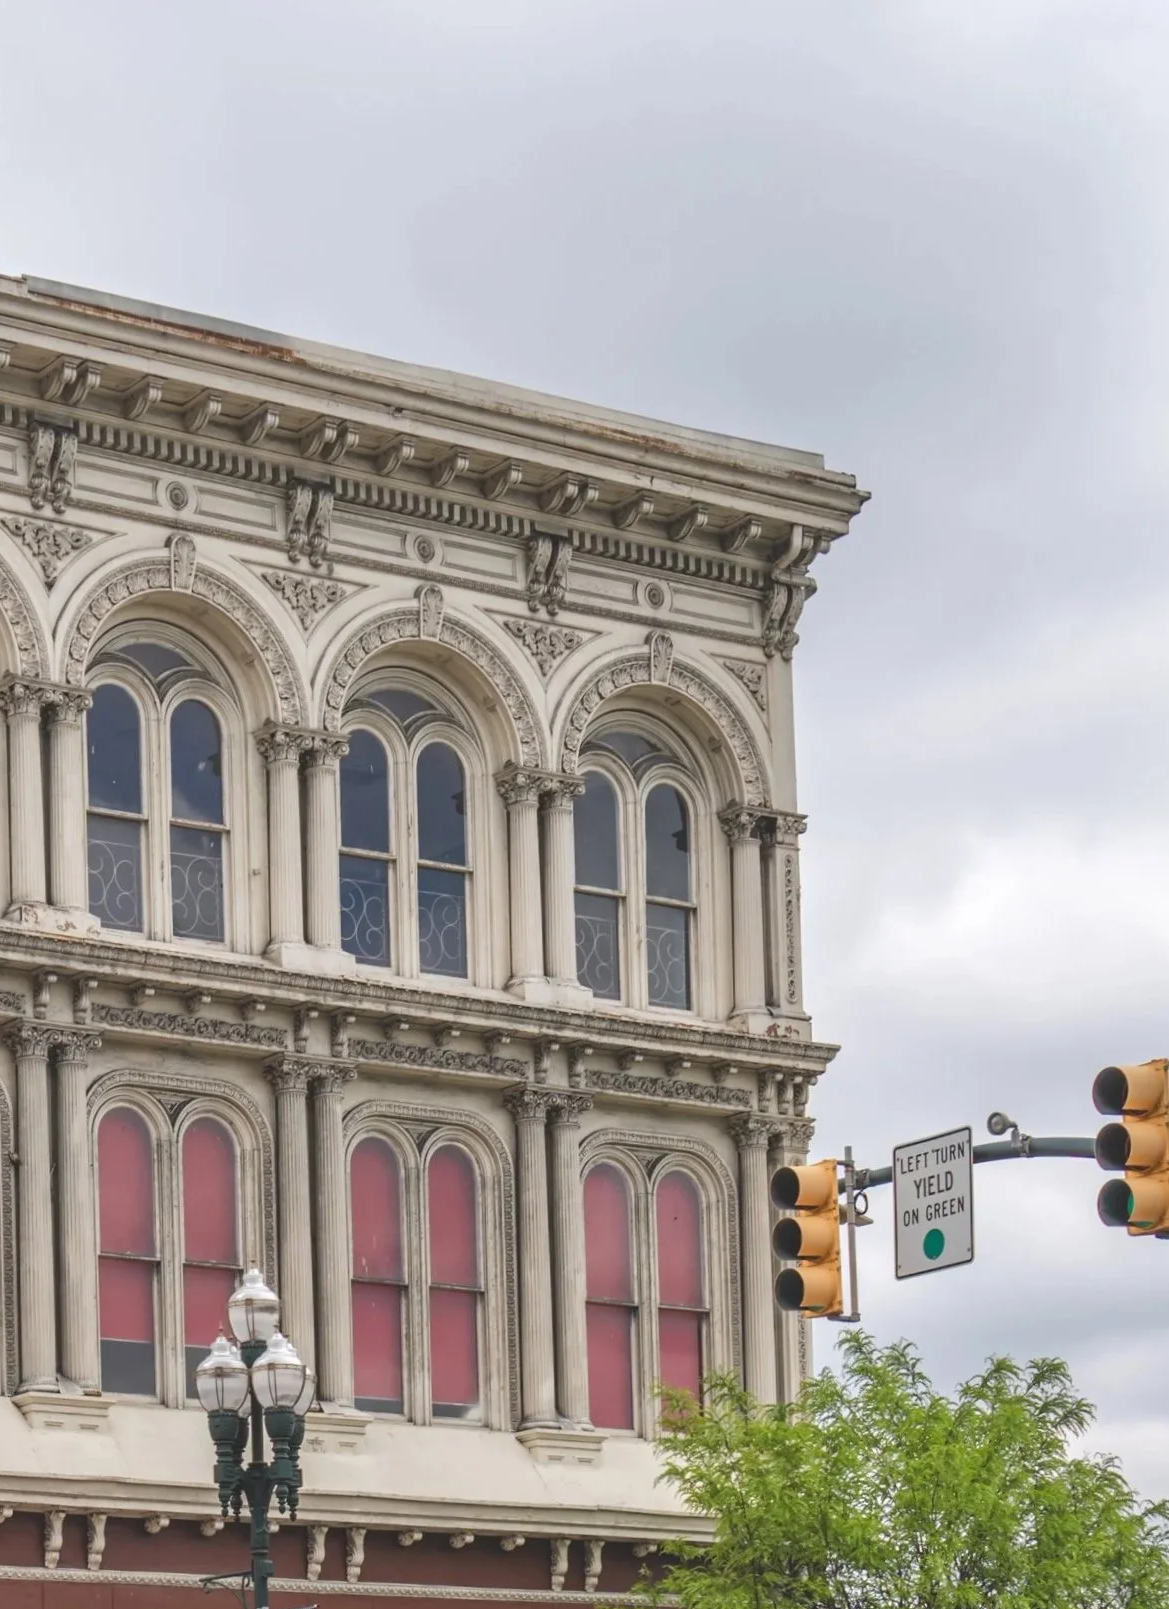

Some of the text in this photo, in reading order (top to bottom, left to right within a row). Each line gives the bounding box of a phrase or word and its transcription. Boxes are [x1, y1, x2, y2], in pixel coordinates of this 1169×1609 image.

[900, 1141, 965, 1175] LEFT TURN
[913, 1170, 954, 1199] YIELD
[903, 1195, 965, 1227] ON GREEN
